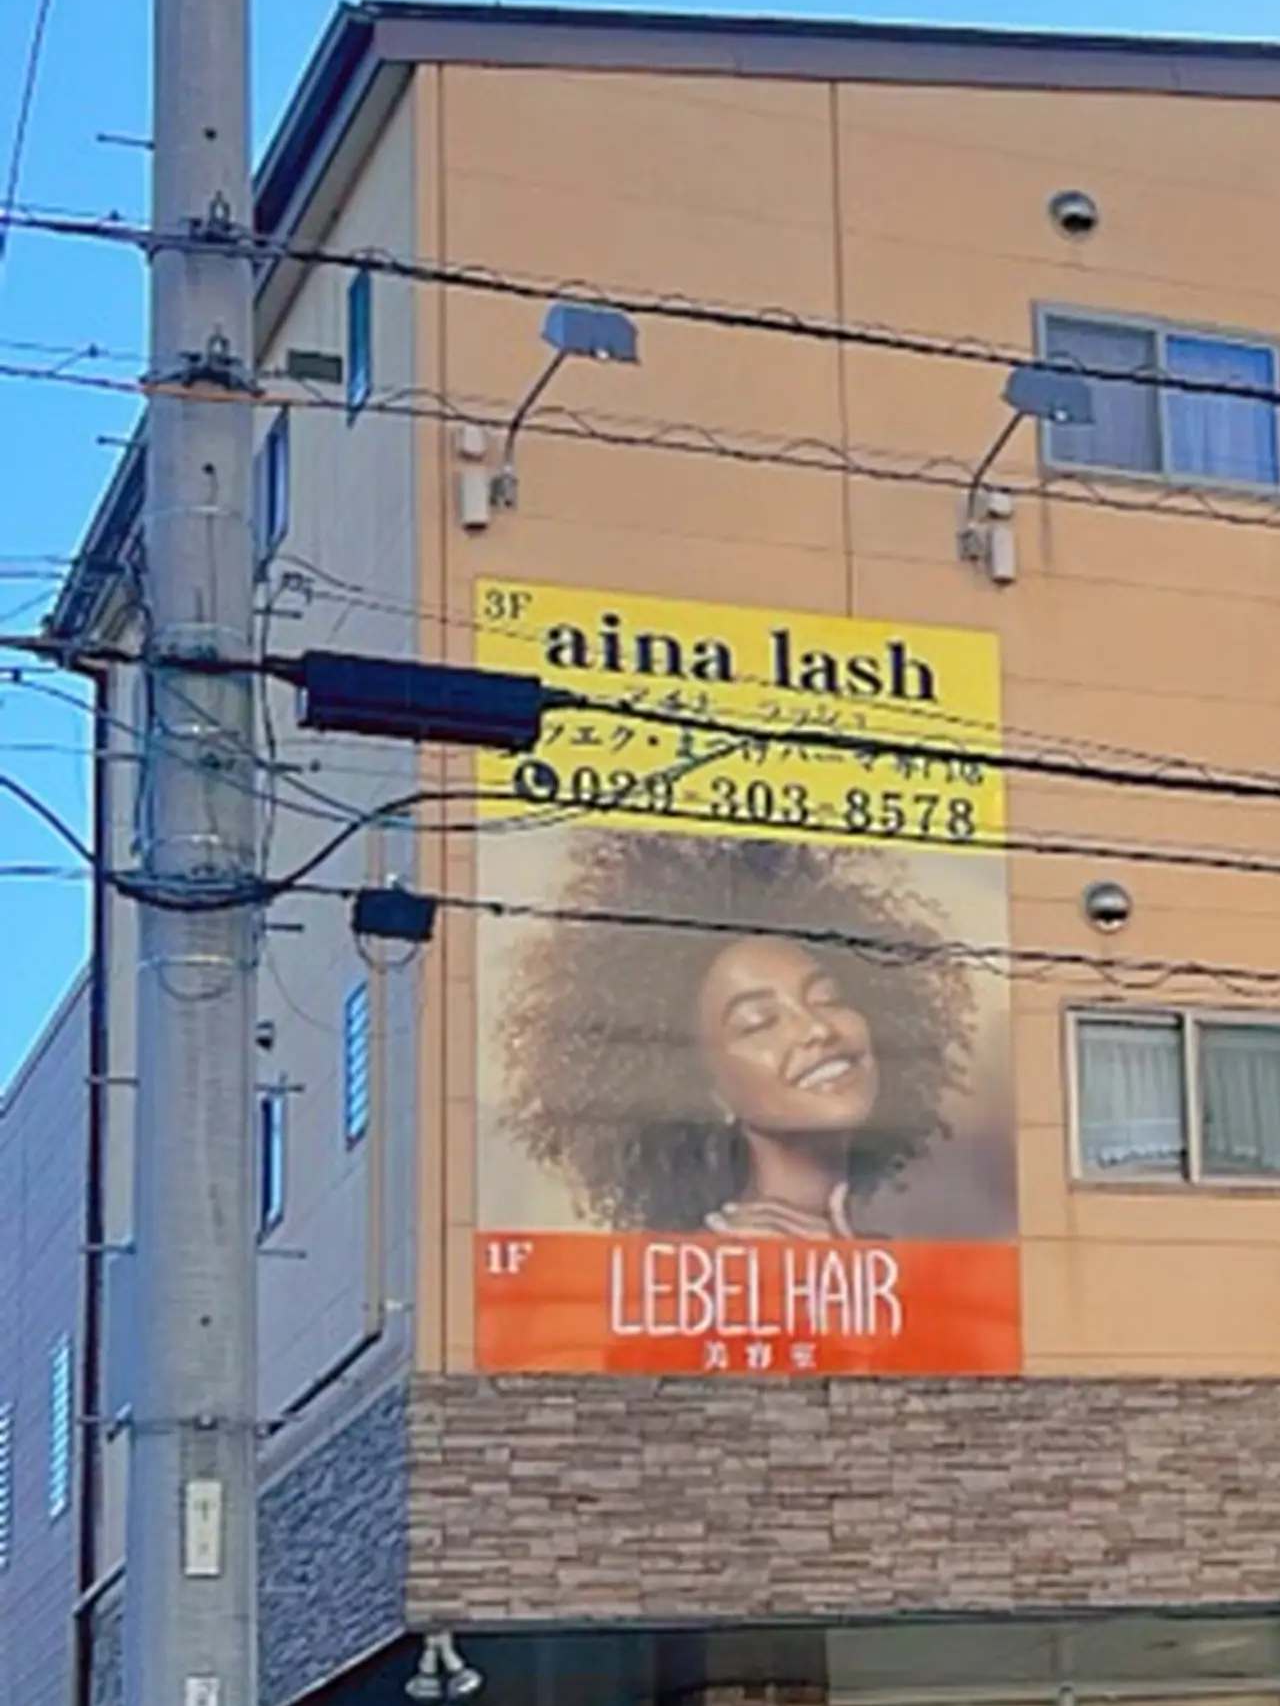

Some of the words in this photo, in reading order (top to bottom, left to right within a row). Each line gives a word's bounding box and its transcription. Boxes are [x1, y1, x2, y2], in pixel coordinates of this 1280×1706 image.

[484, 590, 532, 621] 3F
[545, 614, 733, 681] aina
[770, 630, 937, 702] lash
[485, 1241, 533, 1274] 1F
[611, 1244, 781, 1335] LEBEL
[784, 1248, 900, 1336] HAIR
